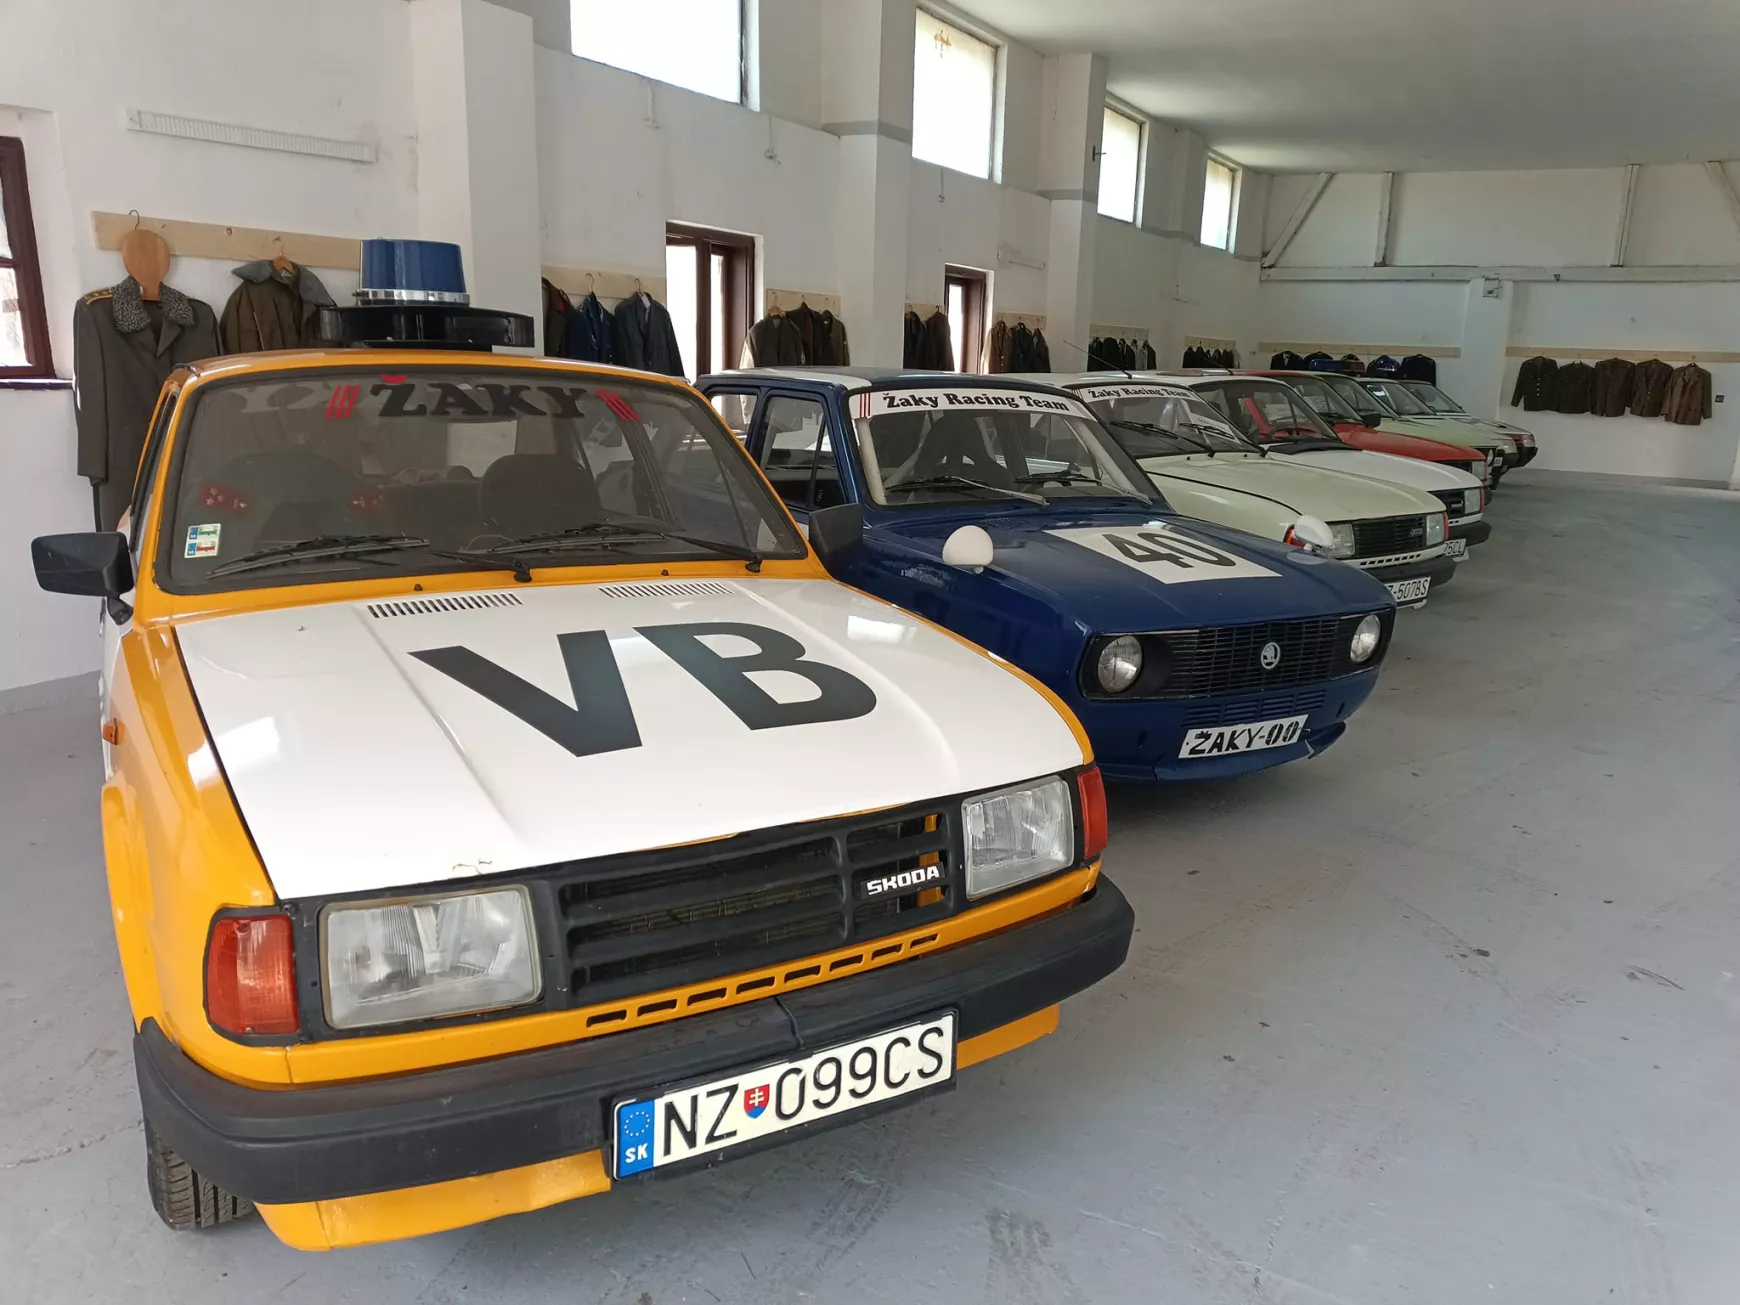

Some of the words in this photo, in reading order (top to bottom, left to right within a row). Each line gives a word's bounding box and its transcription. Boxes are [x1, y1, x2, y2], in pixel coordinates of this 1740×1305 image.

[370, 375, 588, 418] ŽAKY
[883, 392, 939, 408] Žaky
[943, 393, 1016, 409] Racing
[1019, 395, 1070, 411] Team
[1121, 388, 1164, 397] Racing
[1162, 389, 1191, 398] Team
[1102, 532, 1237, 568] 40
[406, 622, 877, 757] VB
[866, 865, 939, 895] SKODA
[663, 1083, 740, 1157] NZ
[775, 1026, 944, 1121] 099CS
[625, 1143, 648, 1164] SK
